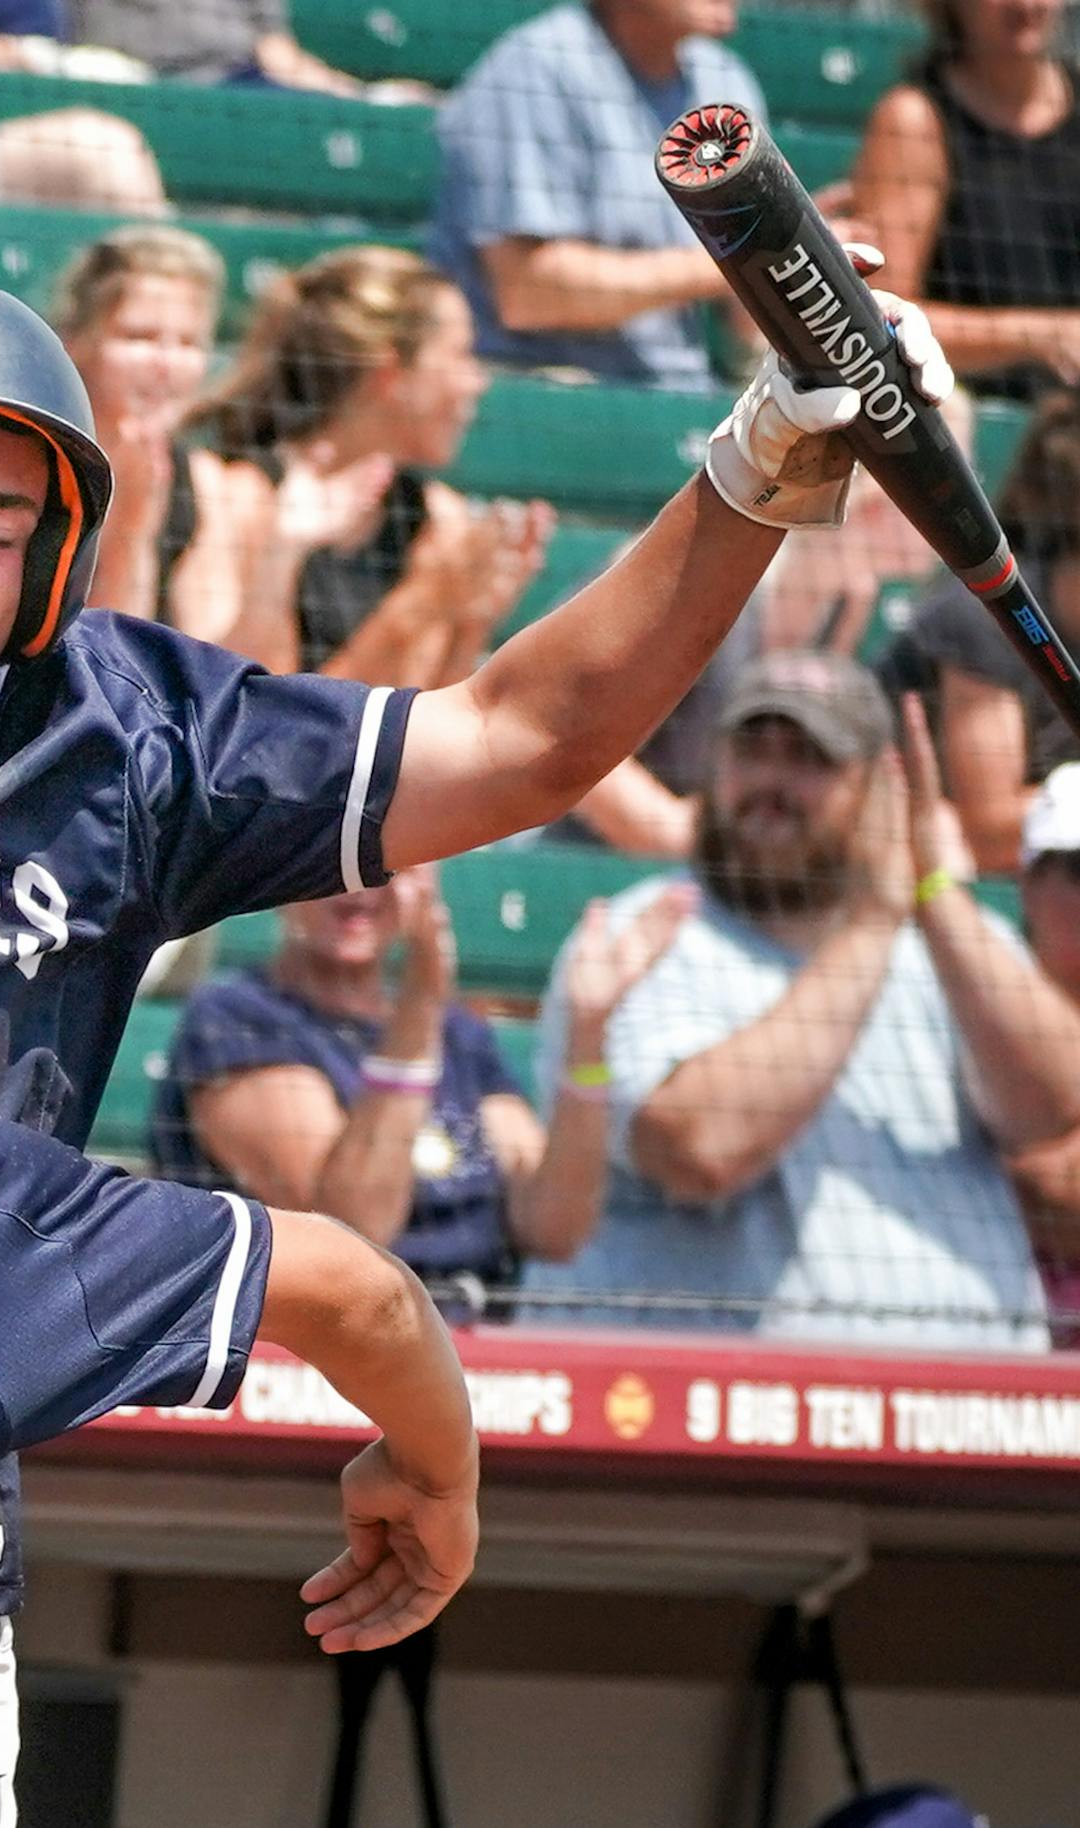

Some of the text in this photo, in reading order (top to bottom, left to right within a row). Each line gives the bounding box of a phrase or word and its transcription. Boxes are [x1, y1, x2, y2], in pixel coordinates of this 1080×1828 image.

[768, 244, 917, 440] LOUISVILLE
[727, 1379, 798, 1445] BIG
[805, 1385, 884, 1450] TEN
